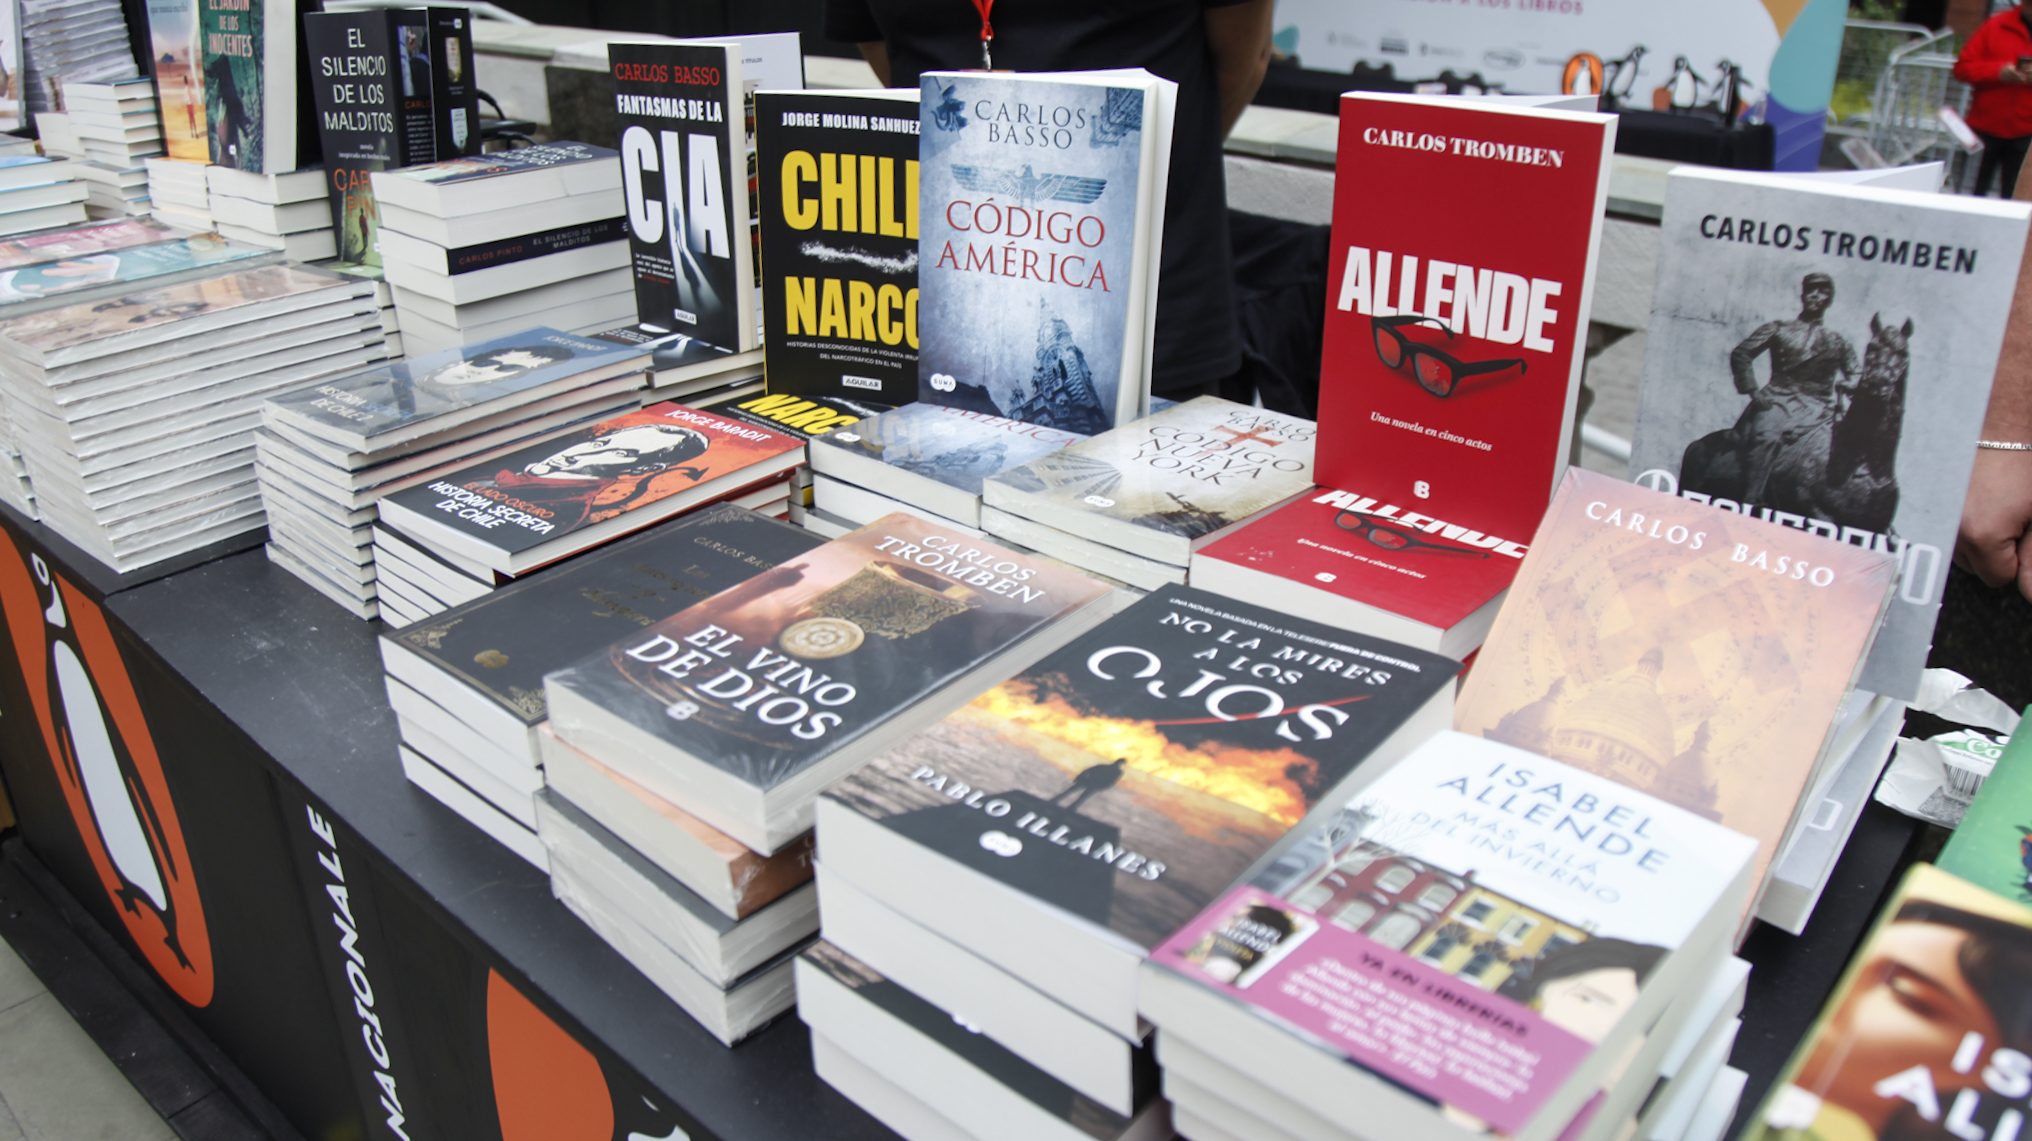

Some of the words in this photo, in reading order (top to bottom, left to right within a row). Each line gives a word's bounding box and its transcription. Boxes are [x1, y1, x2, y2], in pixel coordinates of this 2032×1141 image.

[208, 33, 253, 57] INOCENTES
[348, 28, 366, 48] EL
[321, 55, 387, 77] SILENCIO
[615, 63, 669, 83] CARLOS
[674, 66, 720, 86] BASSO
[333, 83, 357, 104] DE
[360, 84, 385, 105] LOS
[617, 94, 687, 119] FANTASMAS
[688, 100, 704, 121] DE
[706, 101, 723, 122] LA
[323, 110, 394, 133] MALDITOS
[782, 112, 820, 128] JORGE
[822, 113, 868, 131] MOLINA
[975, 100, 1087, 129] CARLOS
[988, 123, 1073, 150] BASSO
[1362, 127, 1447, 153] CARLOS
[1450, 136, 1565, 168] TROMBEN
[622, 126, 730, 258] CIA
[532, 236, 543, 245] EL
[545, 229, 581, 244] SILENCIO
[583, 227, 593, 236] DE
[552, 235, 591, 248] MALDITOS
[946, 198, 1105, 249] CÓDIGO
[459, 252, 494, 266] CARLOS
[1700, 213, 1813, 252] CARLOS
[1820, 228, 1978, 274] TROMBEN
[935, 240, 1112, 293] AMÉRICA
[1337, 245, 1563, 353] ALLENDE
[786, 341, 817, 349] HISTORIAS
[817, 342, 861, 353] DESCONOCIDAS
[879, 349, 904, 359] VIOLENTA
[845, 378, 879, 388] AGUILAR
[664, 408, 710, 430] JORGE
[709, 420, 773, 443] BARADIT
[1226, 416, 1309, 442] BASSO
[1370, 411, 1390, 426] Una
[1391, 417, 1424, 436] novela
[1425, 427, 1438, 438] en
[1438, 428, 1464, 446] cinco
[1465, 436, 1493, 452] actos
[1131, 449, 1233, 486] YORK
[1139, 437, 1264, 480] NUEVA
[428, 480, 493, 511] HISTORIA
[487, 500, 555, 536] SECRETA
[435, 498, 460, 515] DE
[457, 504, 507, 530] CHILE
[463, 481, 480, 493] EL
[478, 485, 509, 504] LADO
[506, 498, 556, 519] OSCURO
[693, 536, 745, 559] CARLOS
[921, 533, 1038, 582] CARLOS
[1319, 541, 1353, 558] novela
[1354, 553, 1369, 563] en
[1369, 557, 1396, 571] cinco
[1397, 566, 1427, 580] actos
[1585, 500, 1708, 551] CARLOS
[1730, 541, 1835, 588] BASSO
[873, 535, 1045, 605] TROMBEN
[1159, 611, 1213, 635] NO
[1217, 628, 1262, 651] LA
[1271, 645, 1393, 686] MIRES
[1187, 602, 1222, 618] NOVELA
[1221, 612, 1258, 628] BASADA
[1257, 622, 1271, 633] EN
[1270, 626, 1283, 635] LA
[1328, 640, 1361, 656] FUERA
[1360, 649, 1375, 659] DE
[1374, 652, 1422, 673] CONTROL
[683, 623, 736, 659] EL
[738, 645, 857, 709] VINO
[1193, 646, 1218, 661] A
[1230, 655, 1304, 685] LOS
[625, 632, 715, 680] DE
[697, 665, 844, 741] DIOS
[1087, 645, 1350, 743] OJOS
[1487, 761, 1653, 840] ISABEL
[911, 765, 1012, 819] PABLO
[1016, 811, 1167, 882] ILLANES
[1436, 775, 1671, 875] ALLENDE
[1409, 810, 1460, 839] DEL
[1468, 832, 1623, 906] INVIERNO
[1360, 951, 1385, 973] YA
[1390, 964, 1421, 987] EN
